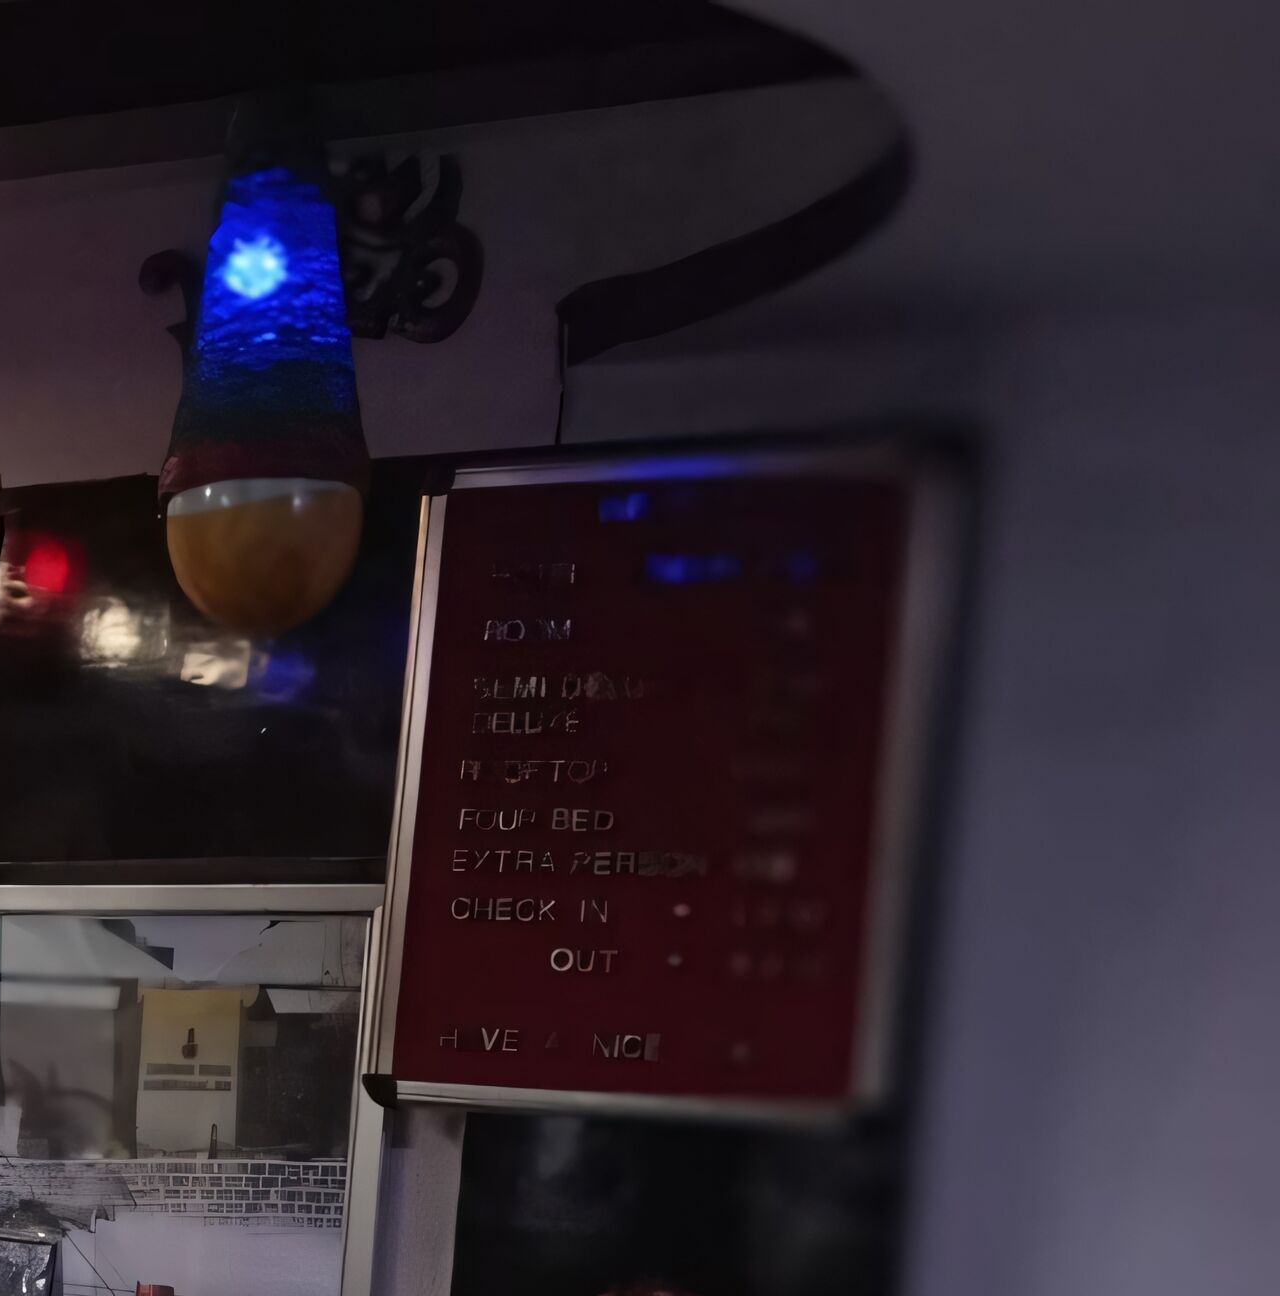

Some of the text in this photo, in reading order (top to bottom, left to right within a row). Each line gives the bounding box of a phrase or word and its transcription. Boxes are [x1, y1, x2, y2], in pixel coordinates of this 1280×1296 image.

[482, 618, 572, 642] ROM
[551, 808, 614, 832] BED
[451, 849, 555, 873] EXTRA
[450, 897, 608, 923] CHECK IN
[549, 947, 619, 973] OUT
[438, 1027, 519, 1052] HVE
